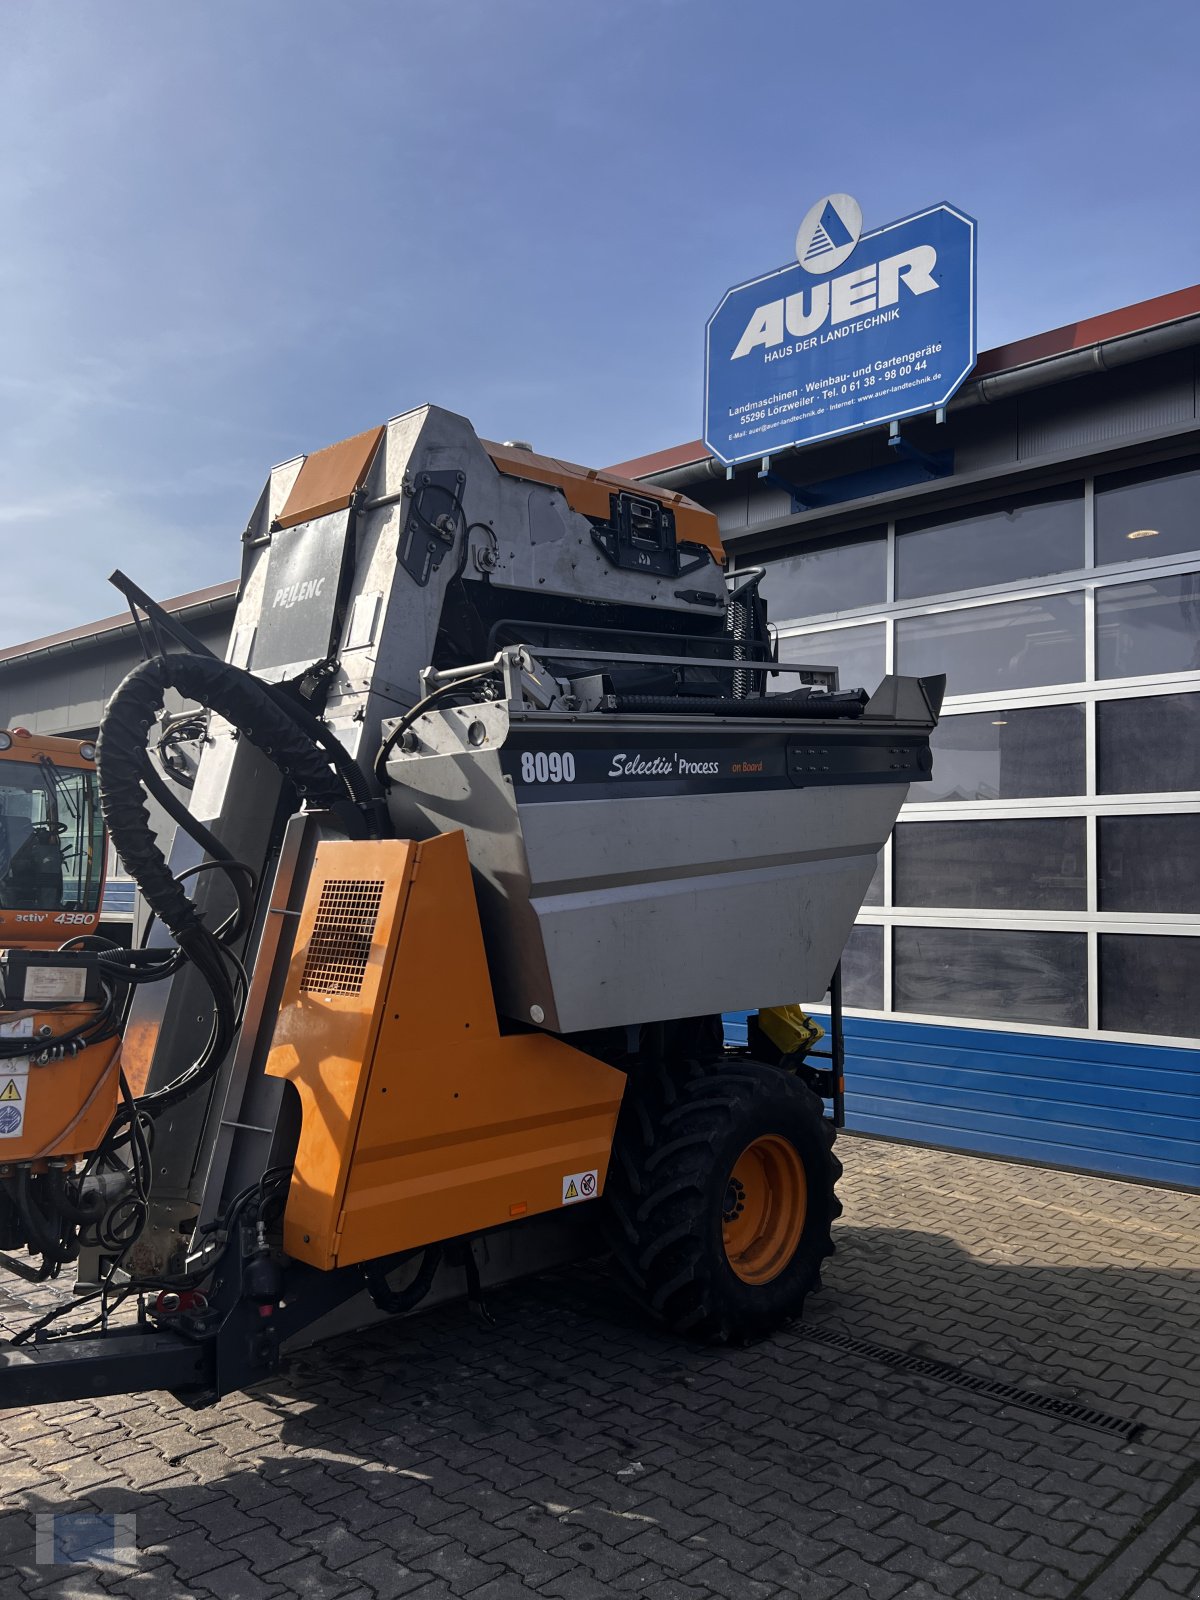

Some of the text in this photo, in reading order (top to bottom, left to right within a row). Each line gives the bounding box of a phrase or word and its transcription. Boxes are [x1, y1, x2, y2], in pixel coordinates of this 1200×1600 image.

[730, 245, 939, 360] AUER
[765, 308, 900, 363] HAUS DER LANDTECHNIK
[728, 373, 942, 440] E-Mail: auer@auer-landtechnik.de Internet: www.auer-landtechnik.de
[729, 344, 942, 416] Landmaschinen Weinbau- und Gartengeräte
[740, 410, 765, 424] 55296
[768, 396, 814, 416] Lörzweiler
[822, 388, 838, 399] Tel.
[841, 385, 847, 393] 0
[850, 380, 860, 391] 61
[864, 376, 875, 387] 38
[885, 370, 896, 380] 98
[900, 365, 911, 376] 00
[914, 360, 927, 371] 44
[521, 752, 576, 783] 8090
[679, 759, 719, 774] Process
[732, 762, 742, 772] on
[743, 761, 762, 772] Board
[54, 913, 95, 925] 4380
